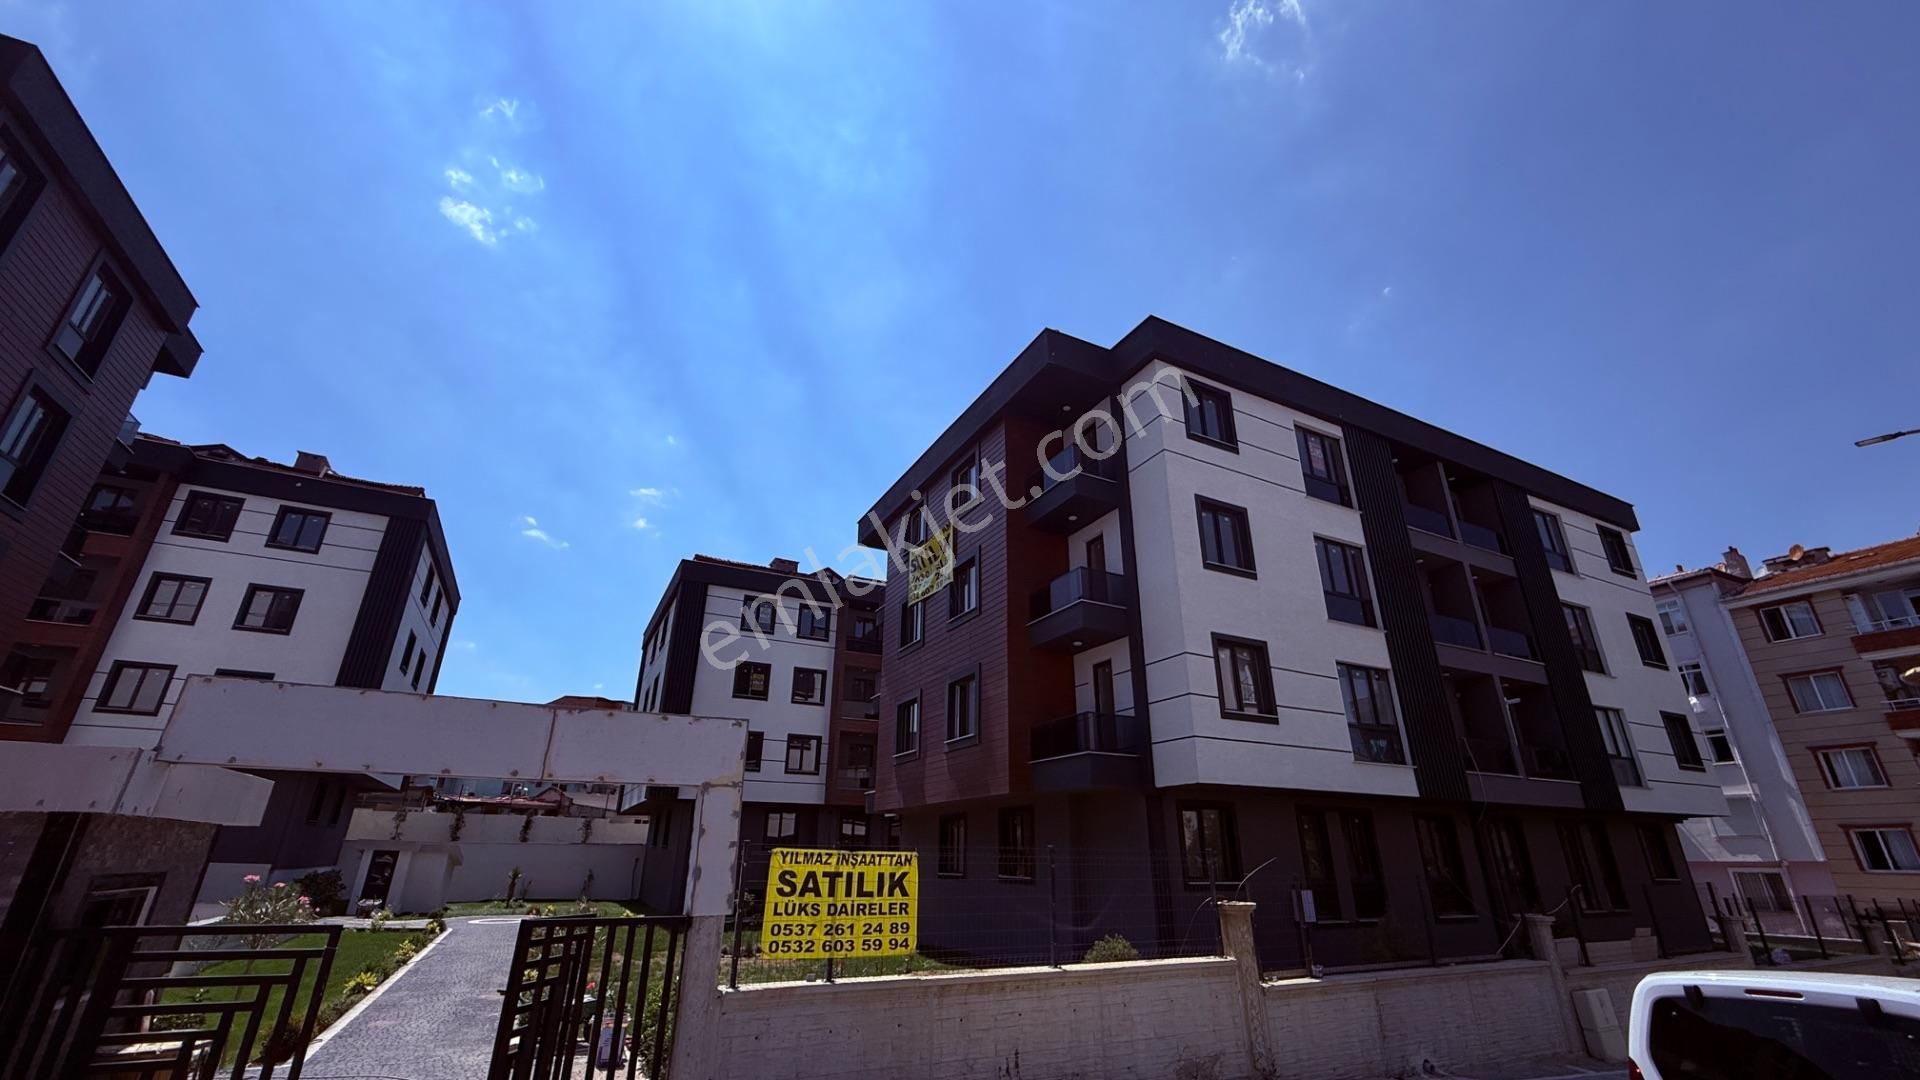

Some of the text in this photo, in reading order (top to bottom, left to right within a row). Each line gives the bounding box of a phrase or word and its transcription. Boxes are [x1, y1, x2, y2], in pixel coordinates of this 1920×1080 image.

[780, 851, 912, 868] YILMAZ İNŞAAT'TAN
[776, 870, 910, 898] SATILIK
[773, 900, 909, 916] LÜKS DAİRELER
[770, 922, 910, 936] 0537 261 24 89
[769, 938, 909, 953] 0532 603 59 94
